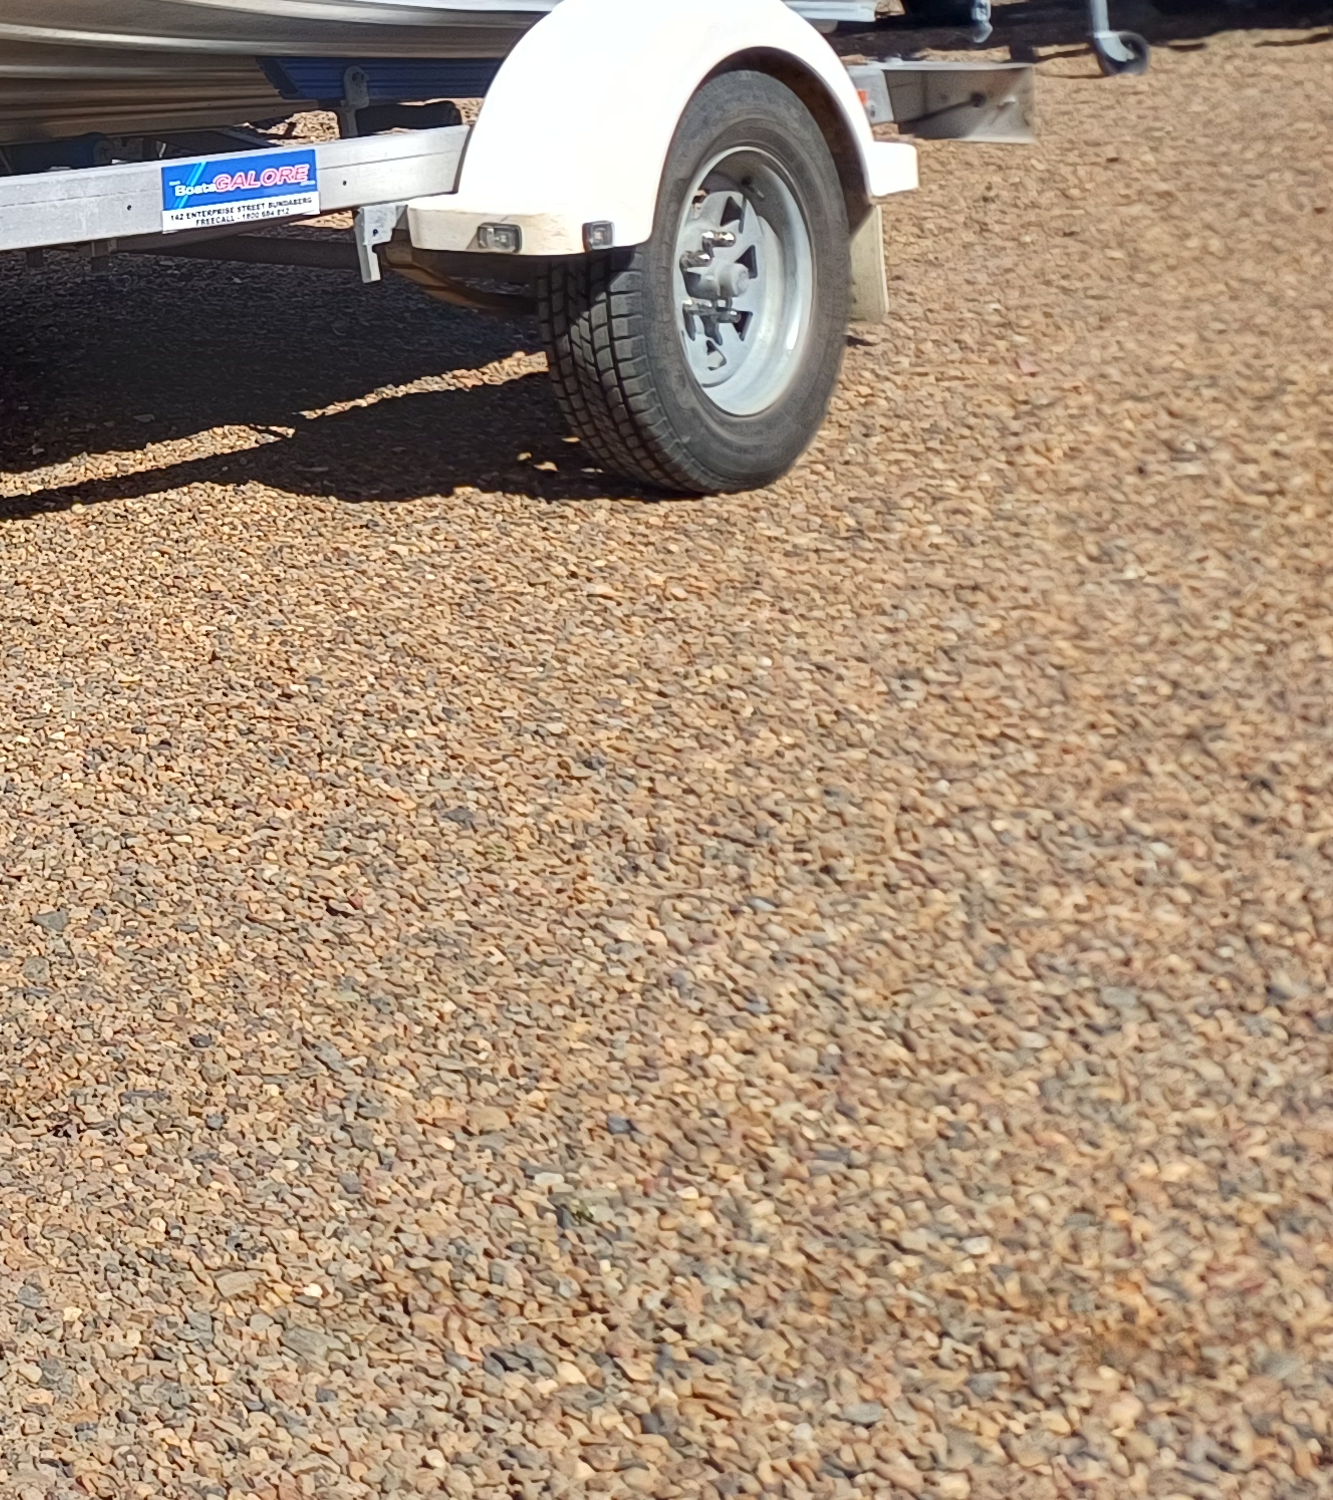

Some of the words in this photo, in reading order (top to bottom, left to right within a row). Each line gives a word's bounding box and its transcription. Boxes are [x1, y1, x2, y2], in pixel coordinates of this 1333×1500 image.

[213, 164, 310, 193] GALORE
[171, 213, 184, 222] 142
[186, 206, 235, 220] ENTERPRISE
[237, 202, 265, 213] STREET
[268, 197, 313, 209] BUNDABERG
[196, 215, 235, 227] FREECALL
